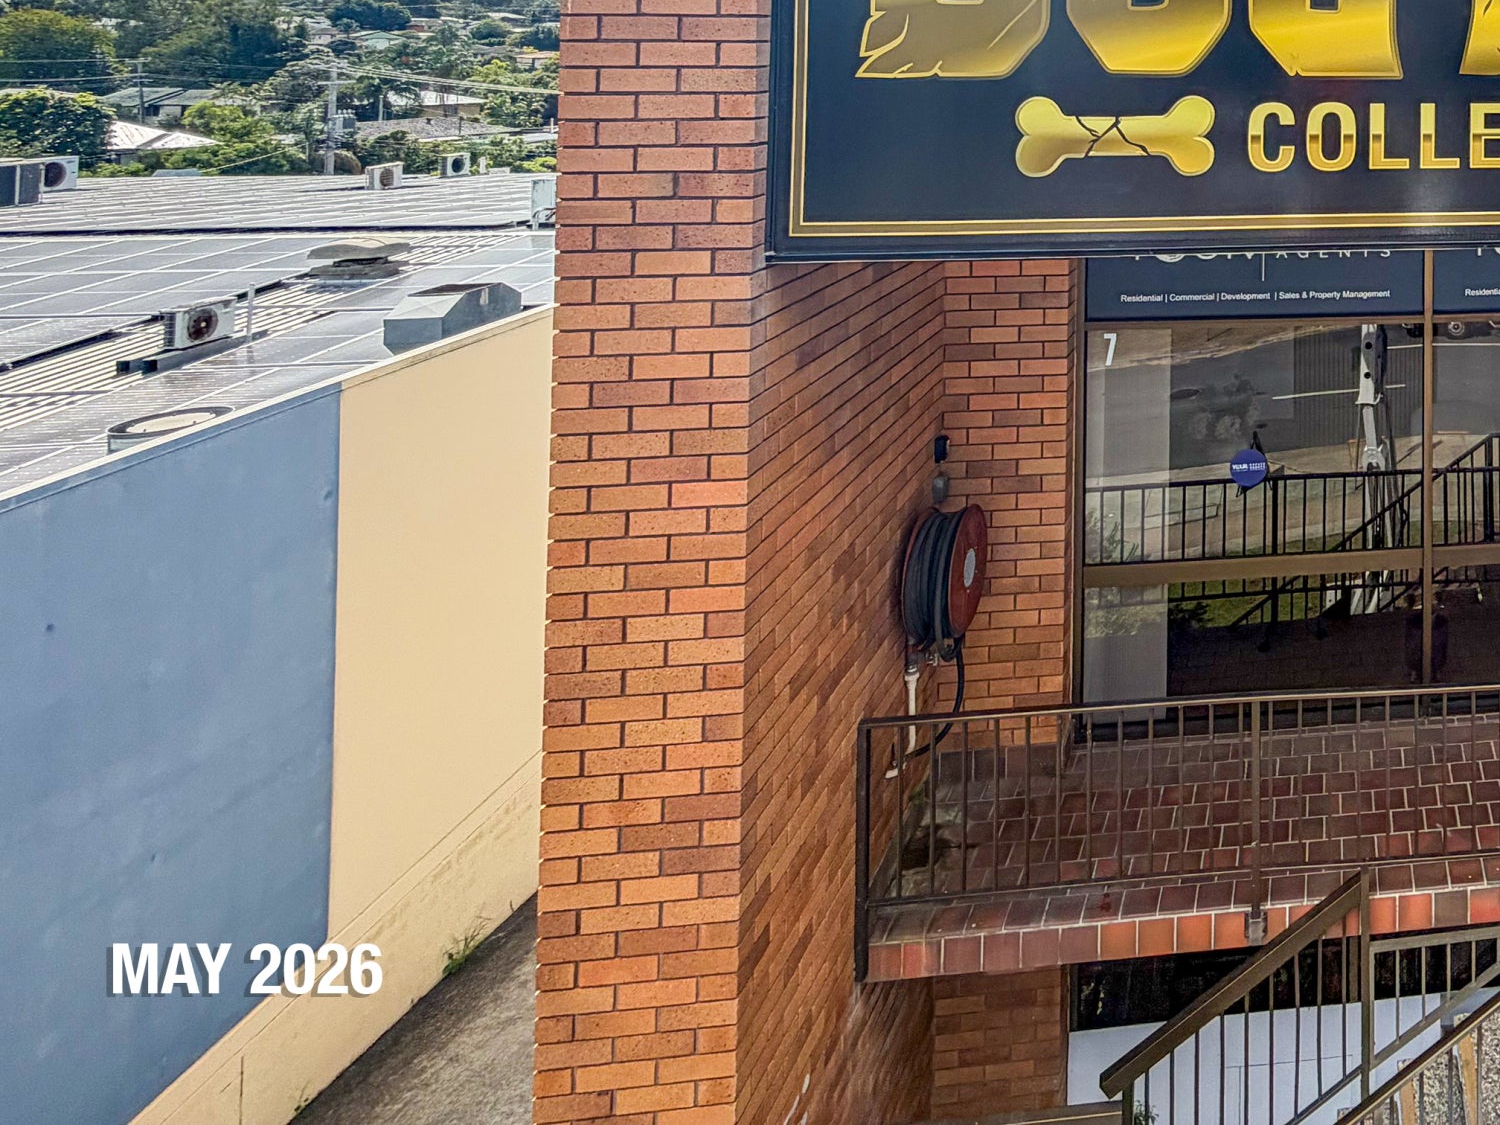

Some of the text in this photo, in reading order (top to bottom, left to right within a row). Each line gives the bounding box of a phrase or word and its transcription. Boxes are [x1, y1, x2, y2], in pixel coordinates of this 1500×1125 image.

[1120, 289, 1391, 303] Residential Commercial Development Sales & Property Management
[1103, 332, 1117, 366] 7
